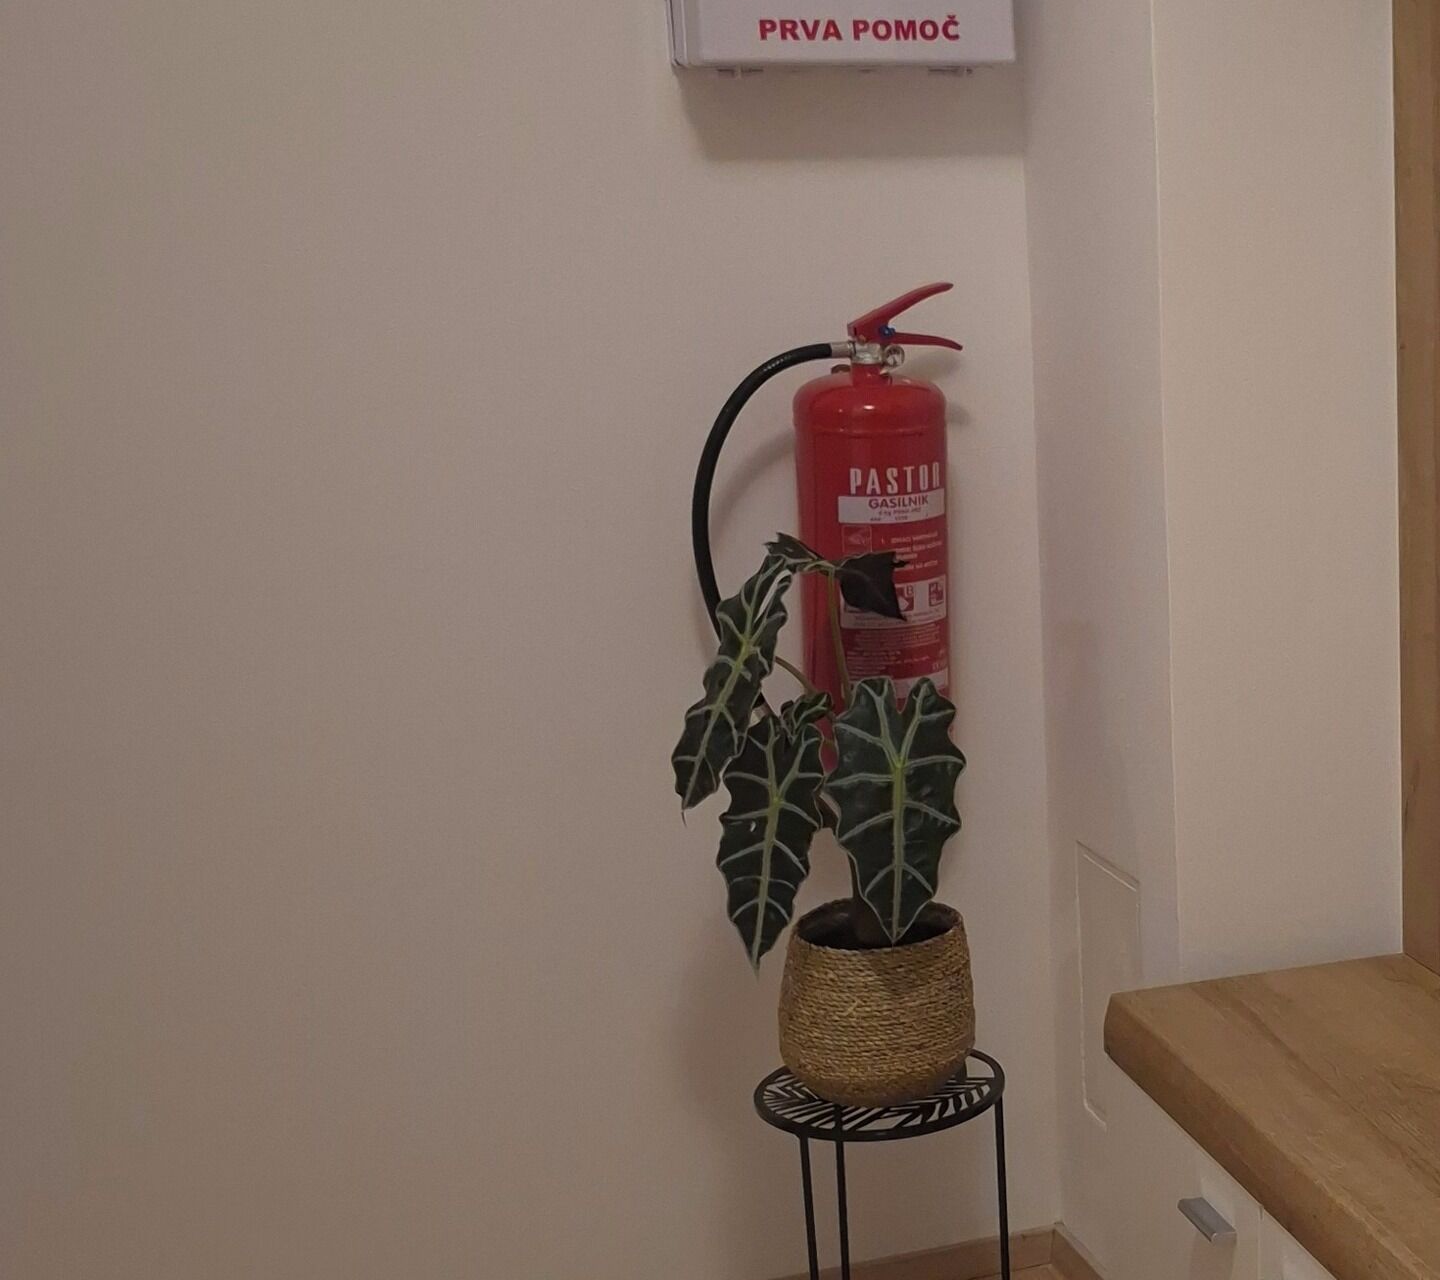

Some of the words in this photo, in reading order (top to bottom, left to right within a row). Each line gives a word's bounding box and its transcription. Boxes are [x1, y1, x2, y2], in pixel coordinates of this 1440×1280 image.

[759, 19, 843, 41] PRVA
[852, 14, 960, 41] POMOČ
[849, 462, 940, 495] PASTOR
[868, 495, 929, 509] GASILNIK
